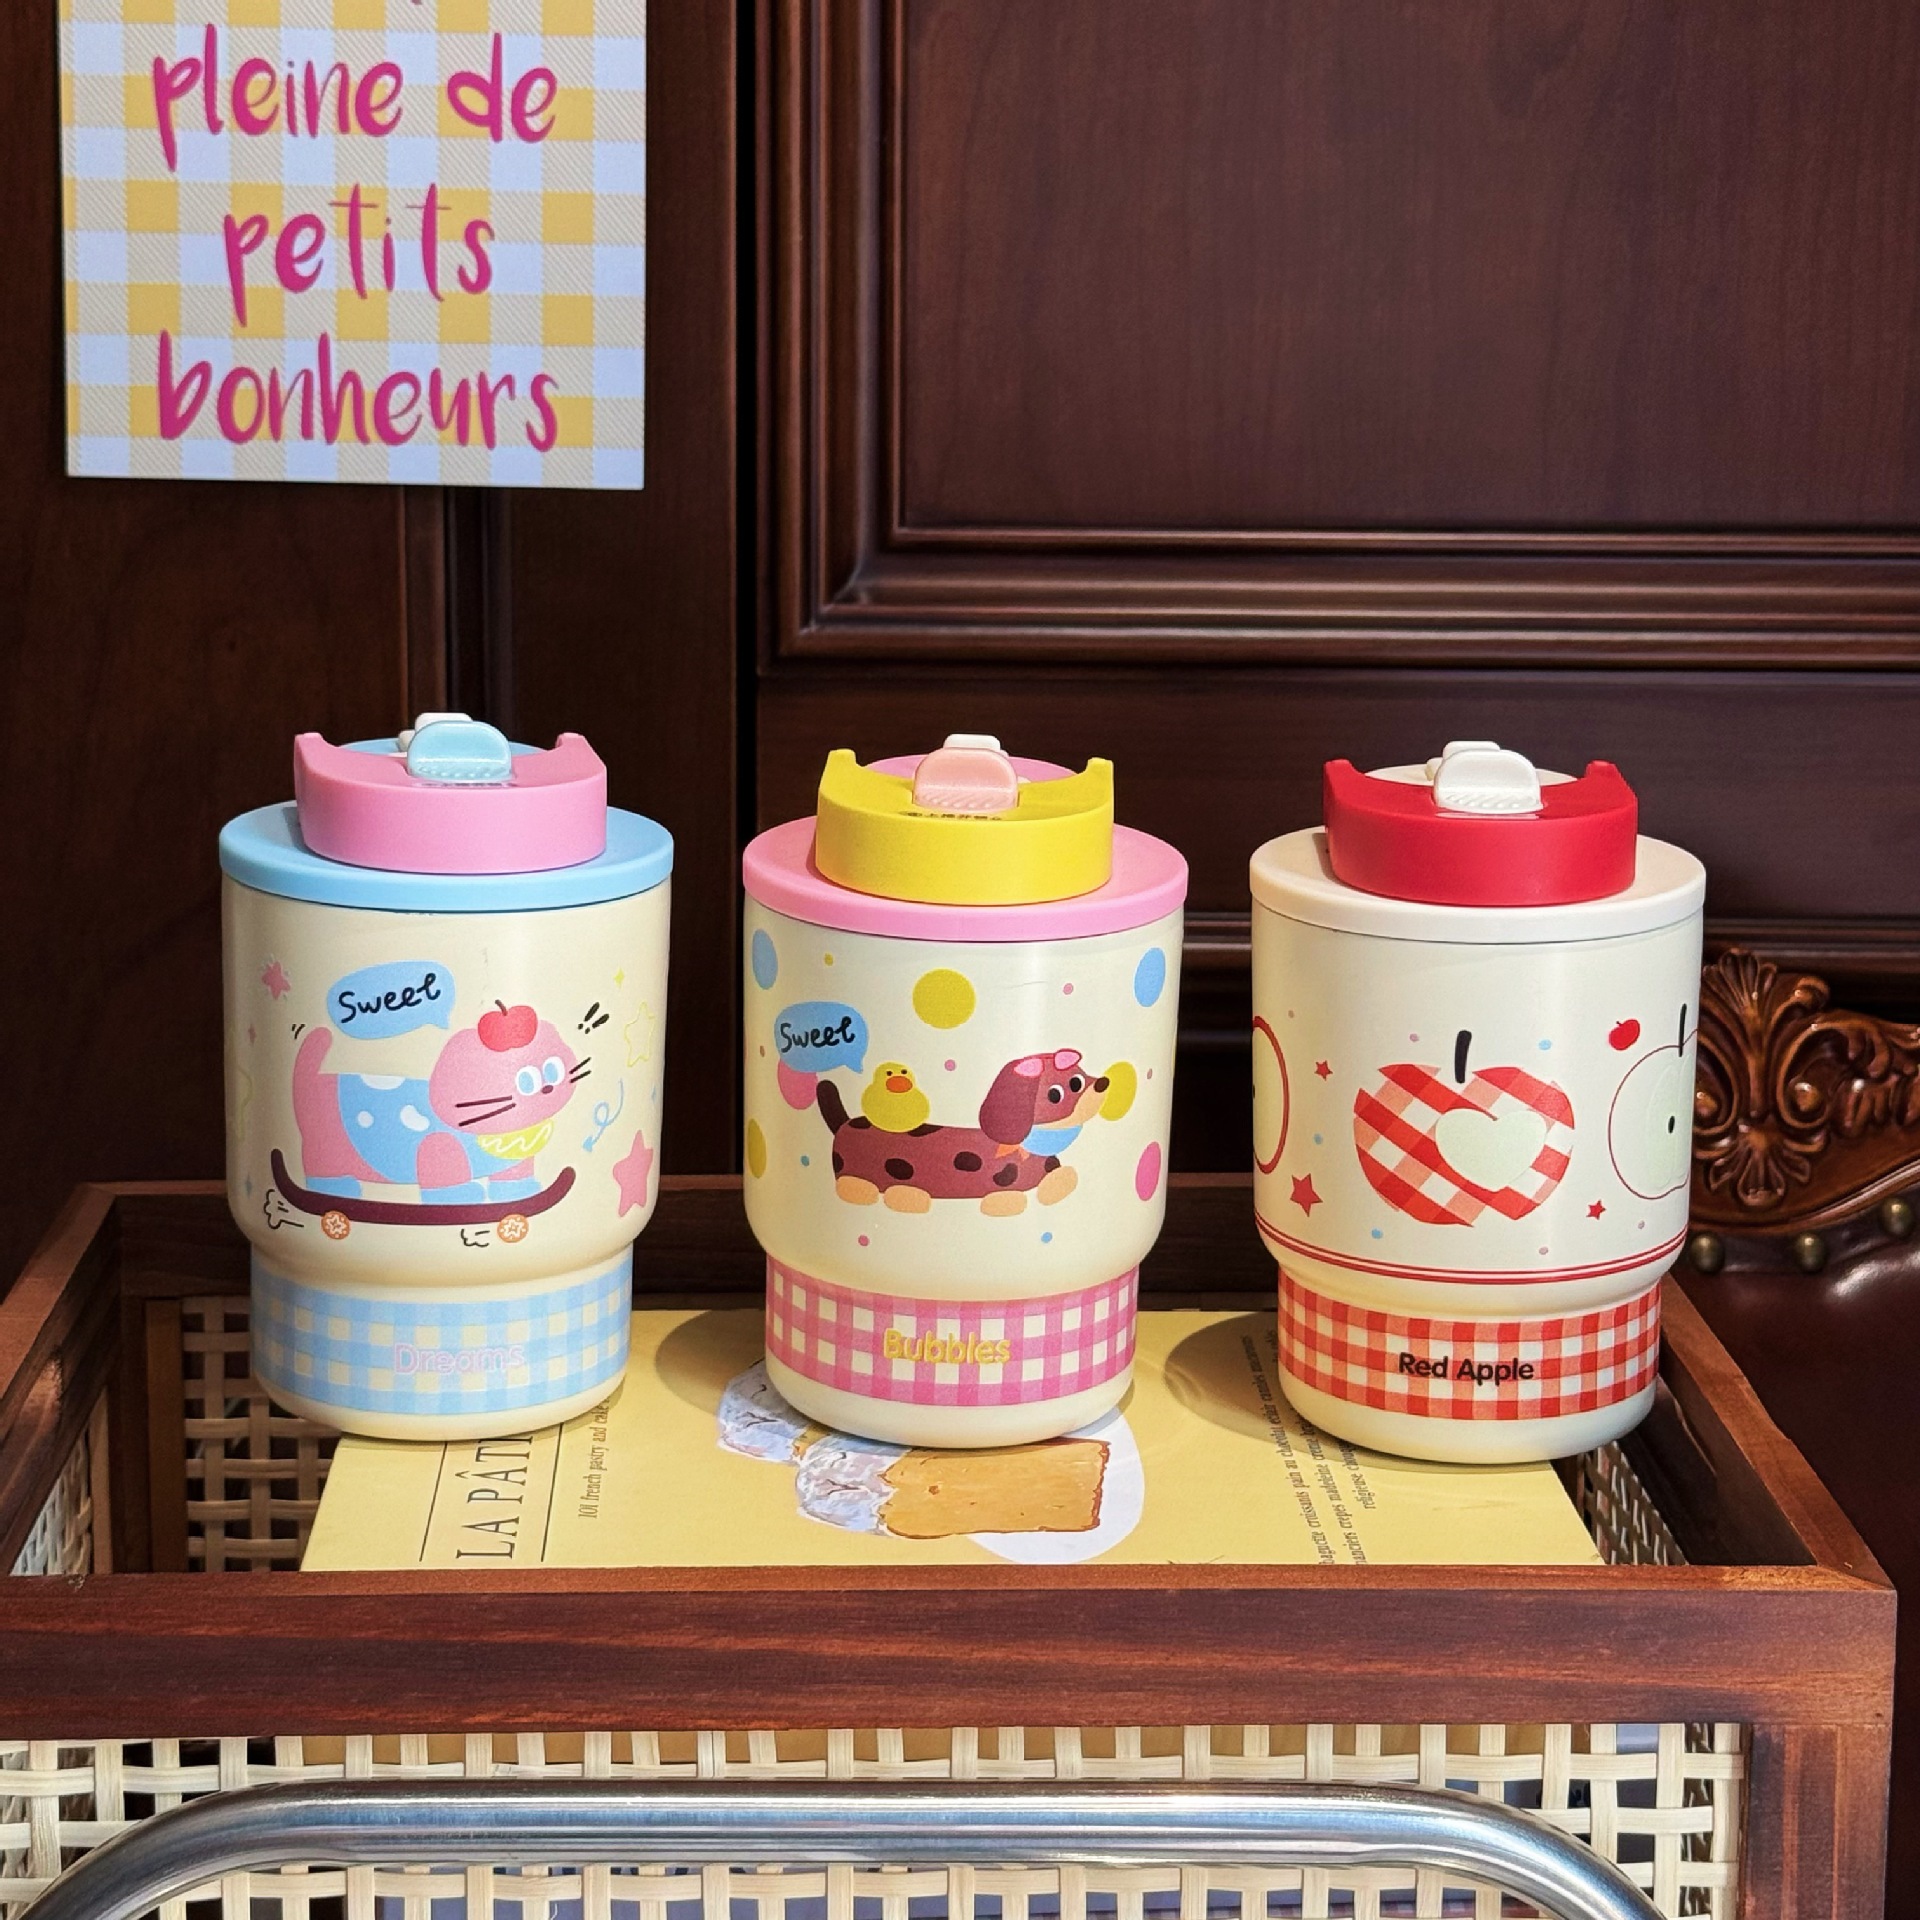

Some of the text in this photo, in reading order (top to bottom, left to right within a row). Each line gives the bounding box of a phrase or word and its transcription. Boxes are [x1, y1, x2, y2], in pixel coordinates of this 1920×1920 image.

[153, 23, 558, 172] pleine de
[223, 183, 495, 328] petits
[158, 329, 559, 453] bonheurs
[338, 972, 441, 1024] Sweet
[780, 1015, 856, 1054] Sweet
[394, 1342, 525, 1375] Dreams
[883, 1327, 1011, 1365] Bubbles
[1398, 1351, 1535, 1387] Red Apple
[589, 1427, 609, 1443] and
[589, 1445, 609, 1471] pastry
[1284, 1460, 1298, 1470] au
[580, 1474, 602, 1501] french
[1285, 1472, 1310, 1488] pain
[578, 1504, 600, 1519] 101
[1332, 1503, 1352, 1528] crepes
[456, 1516, 520, 1559] LA
